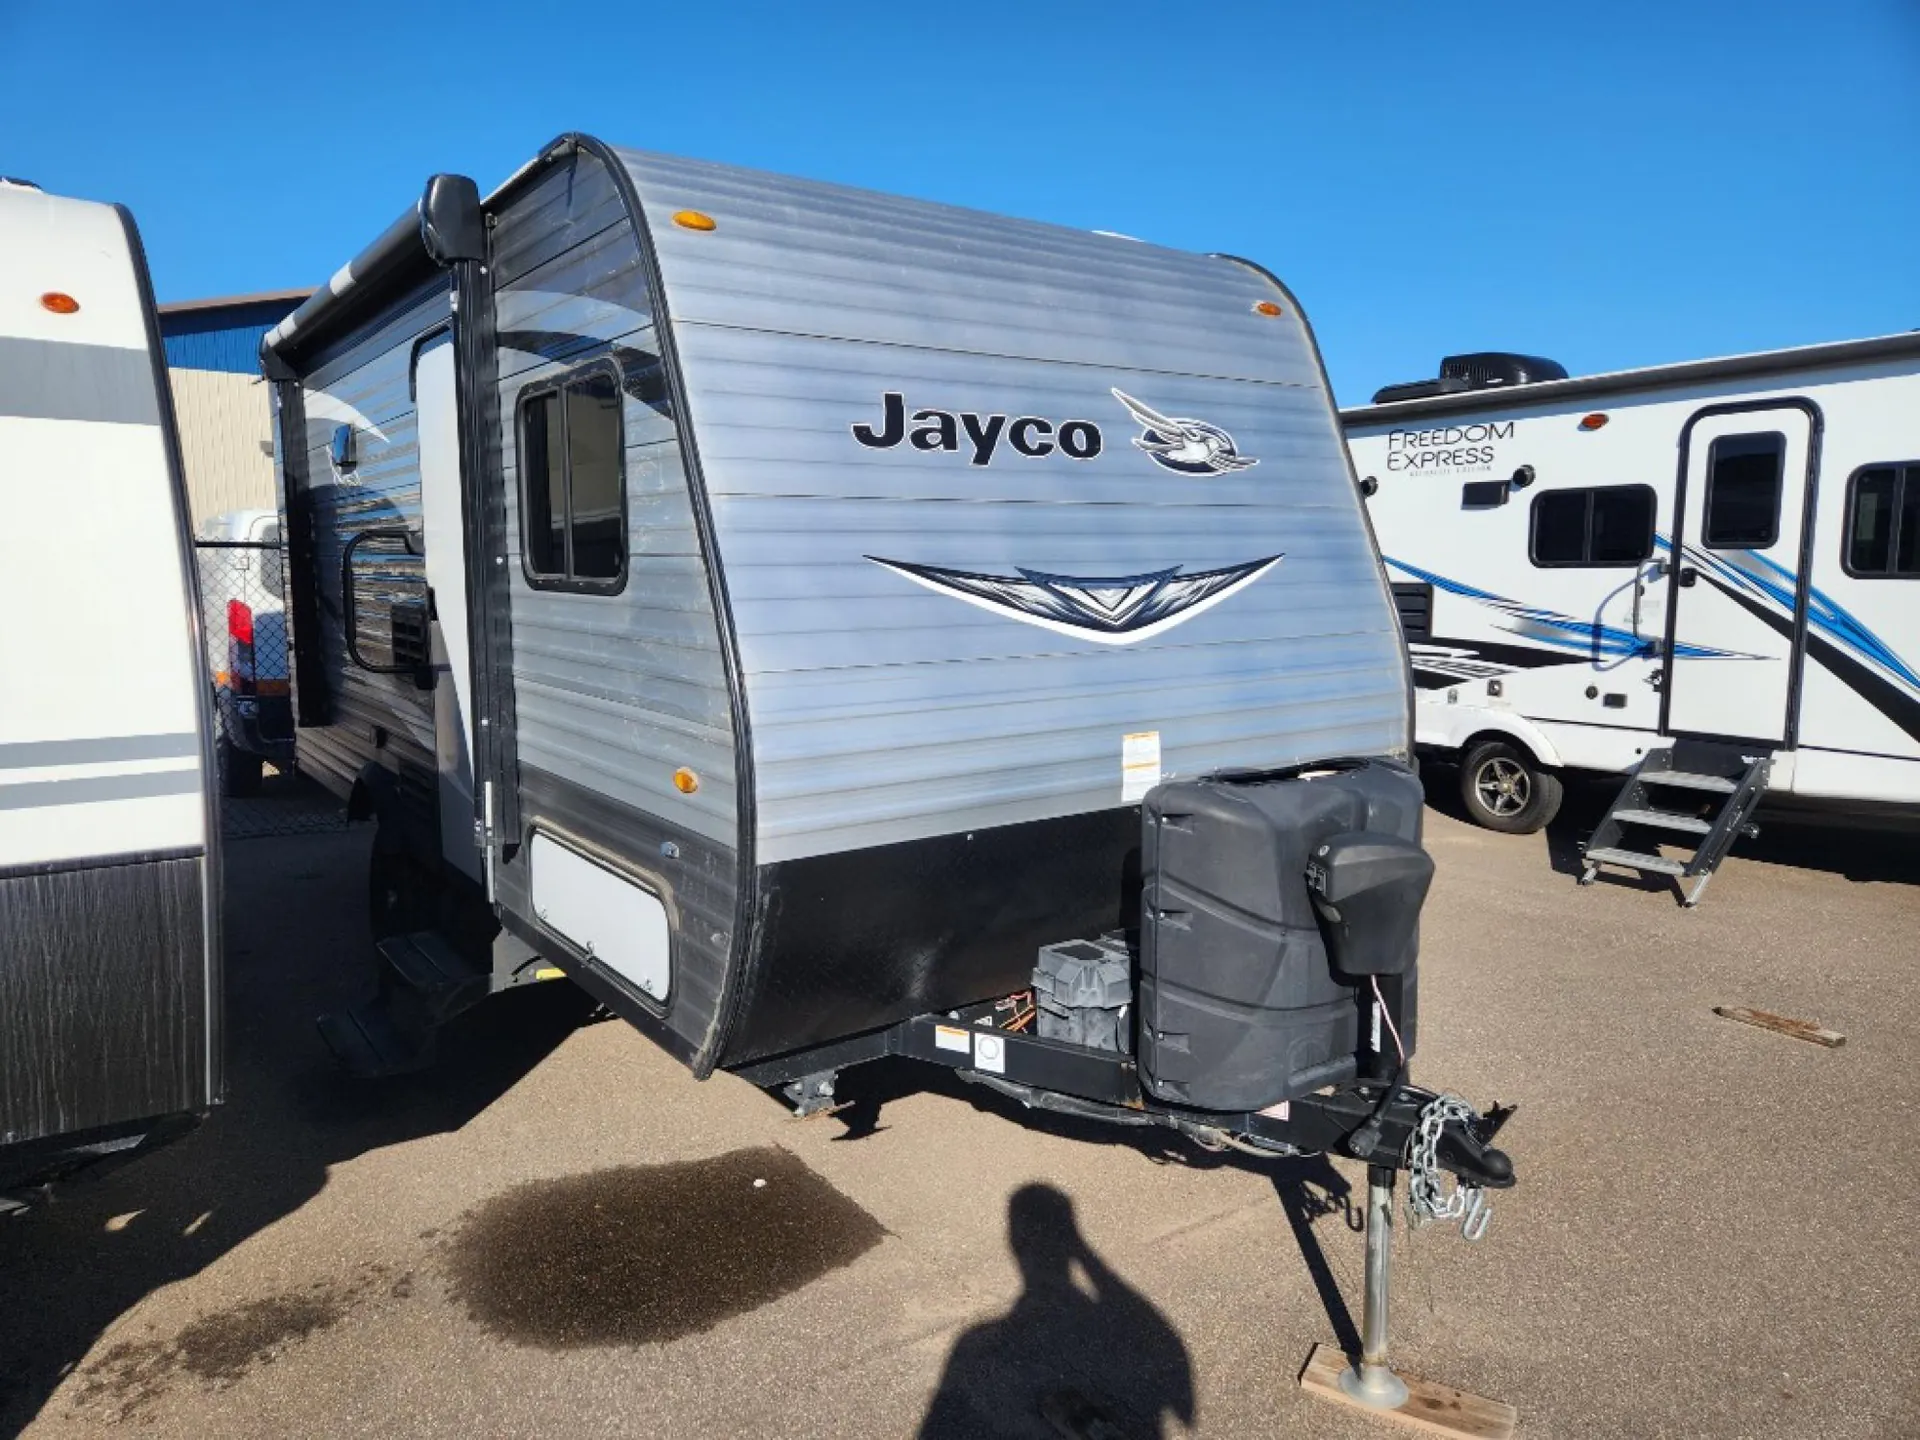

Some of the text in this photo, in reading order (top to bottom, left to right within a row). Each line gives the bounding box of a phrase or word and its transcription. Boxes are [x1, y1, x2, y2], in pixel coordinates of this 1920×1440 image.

[852, 392, 1102, 466] Jayco
[1389, 421, 1514, 450] FREEDOM
[1387, 446, 1494, 471] EXPRESS
